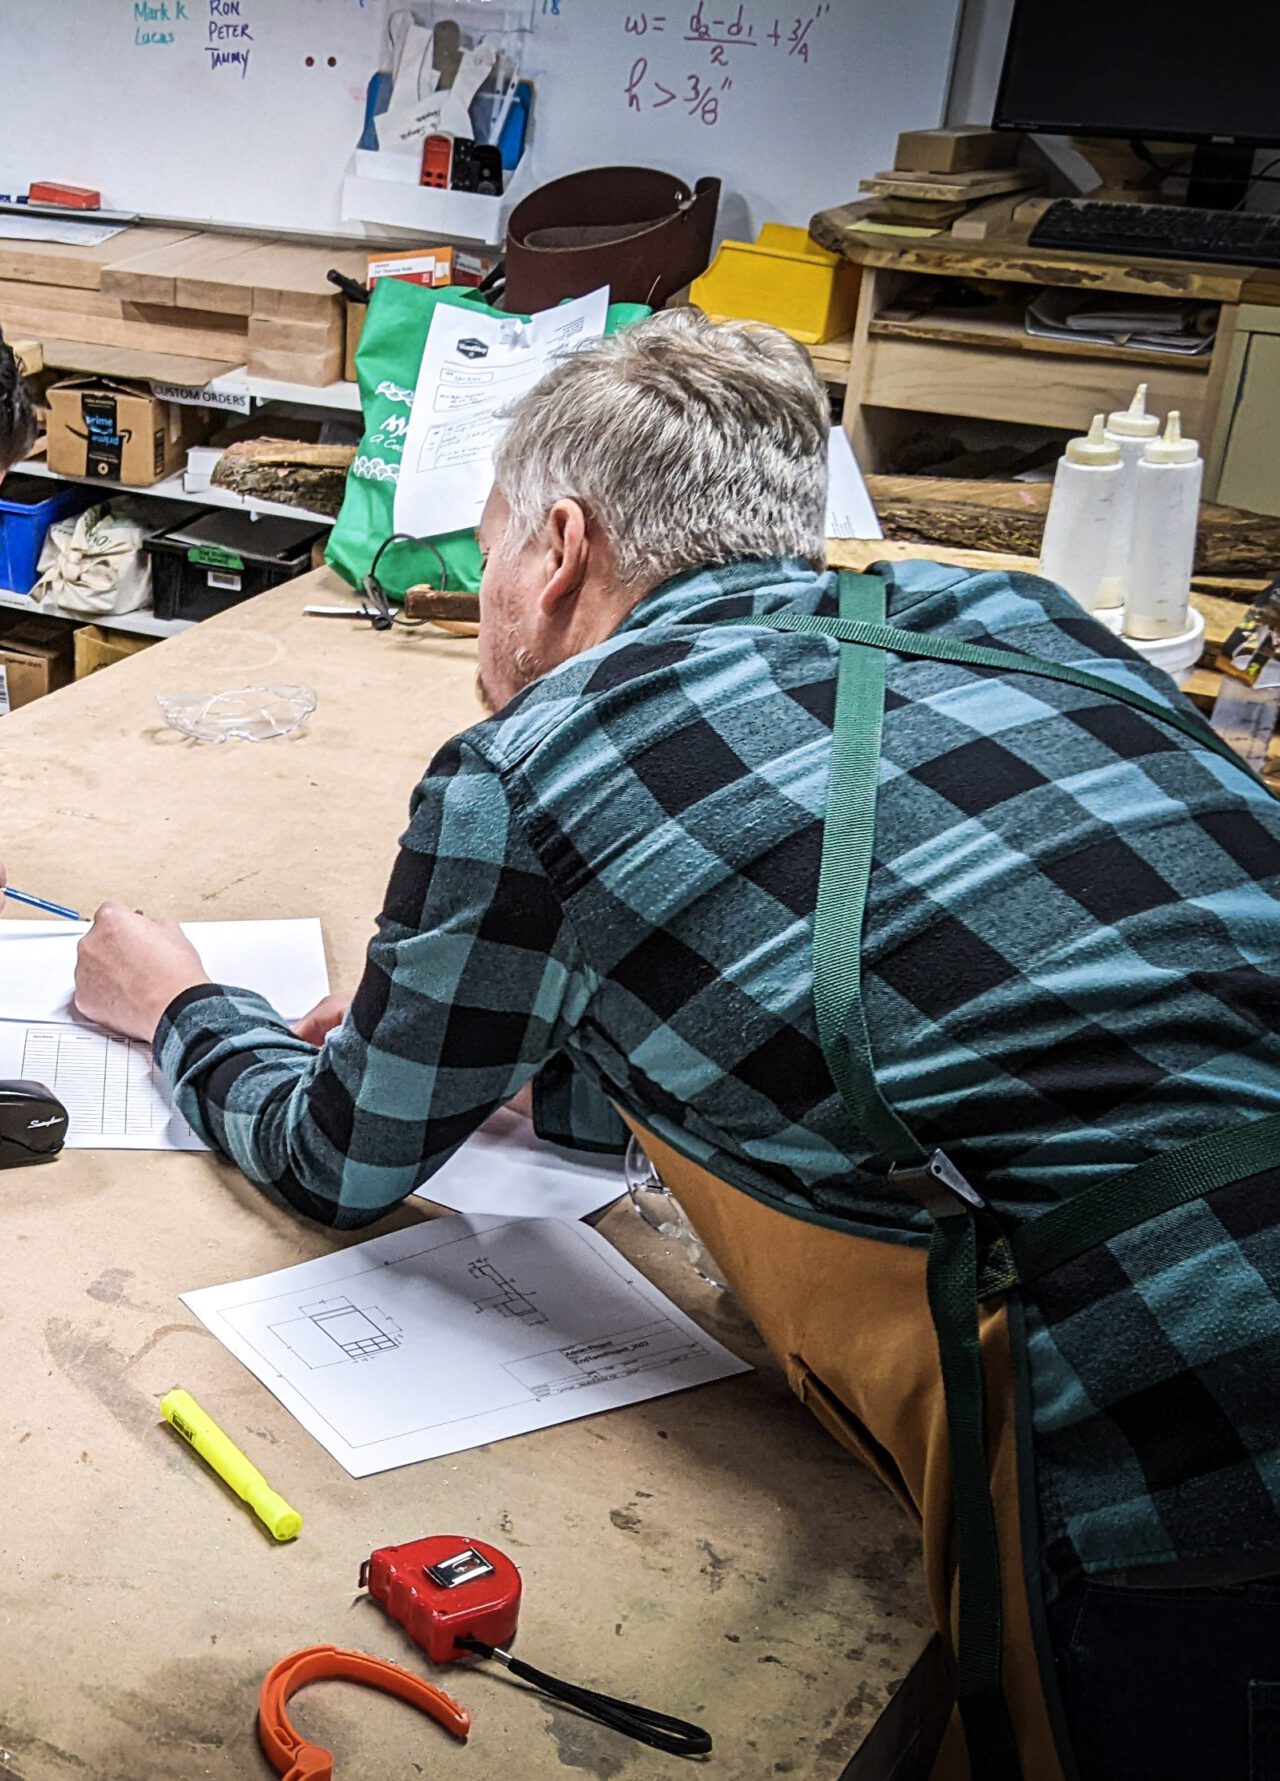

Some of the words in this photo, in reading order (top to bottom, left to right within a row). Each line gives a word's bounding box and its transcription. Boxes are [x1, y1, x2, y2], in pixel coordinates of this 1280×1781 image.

[134, 1, 171, 21] Mark
[209, 0, 240, 16] RON
[134, 26, 175, 46] Lucas
[208, 21, 254, 41] PETER
[204, 47, 250, 79] TAMMY
[154, 384, 200, 401] CUSTOM
[202, 392, 246, 407] ORDERS
